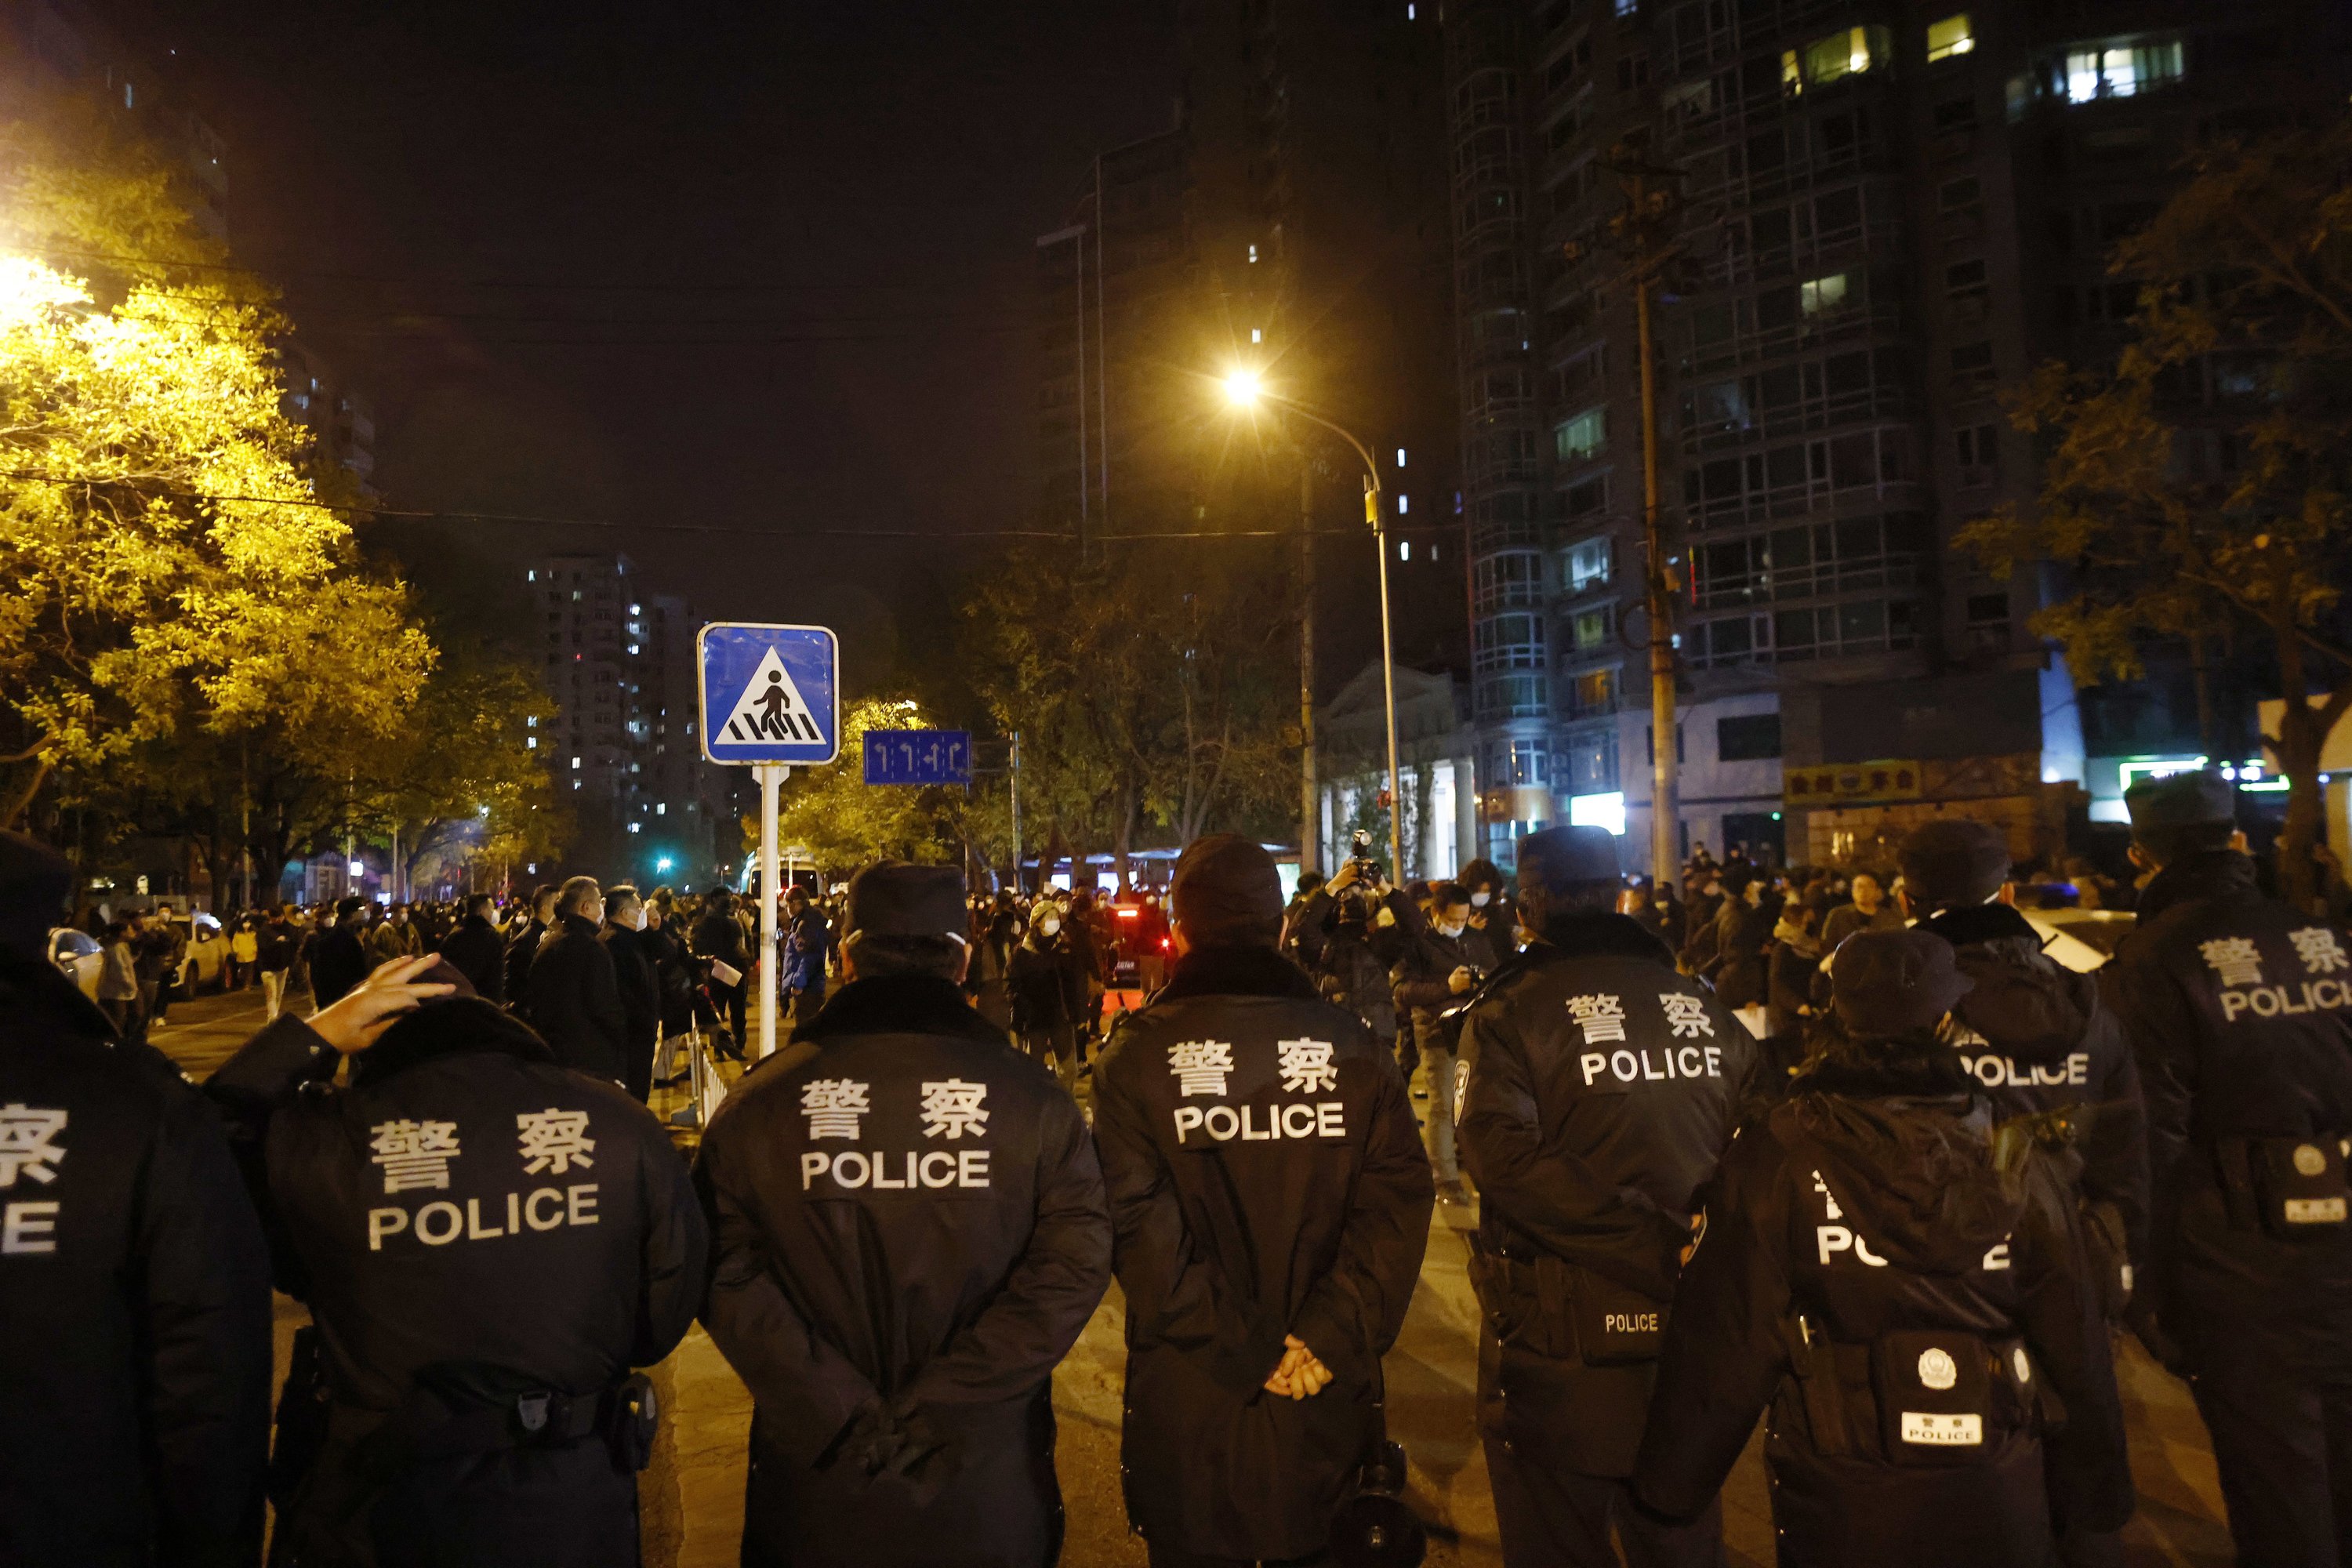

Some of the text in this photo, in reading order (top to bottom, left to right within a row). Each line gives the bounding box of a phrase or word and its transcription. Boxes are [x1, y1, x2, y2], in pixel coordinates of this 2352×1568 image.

[1566, 992, 1715, 1044] 警察
[1168, 1037, 1338, 1096] 警察
[1581, 1047, 1722, 1085] POLICE
[800, 1078, 989, 1140] 警察
[1174, 1102, 1346, 1144] POLICE
[370, 1108, 596, 1194] 警察
[801, 1150, 990, 1190] POLICE
[368, 1184, 599, 1251] POLICE
[1605, 1313, 1658, 1333] POLICE
[1908, 1428, 1973, 1440] POLICE
